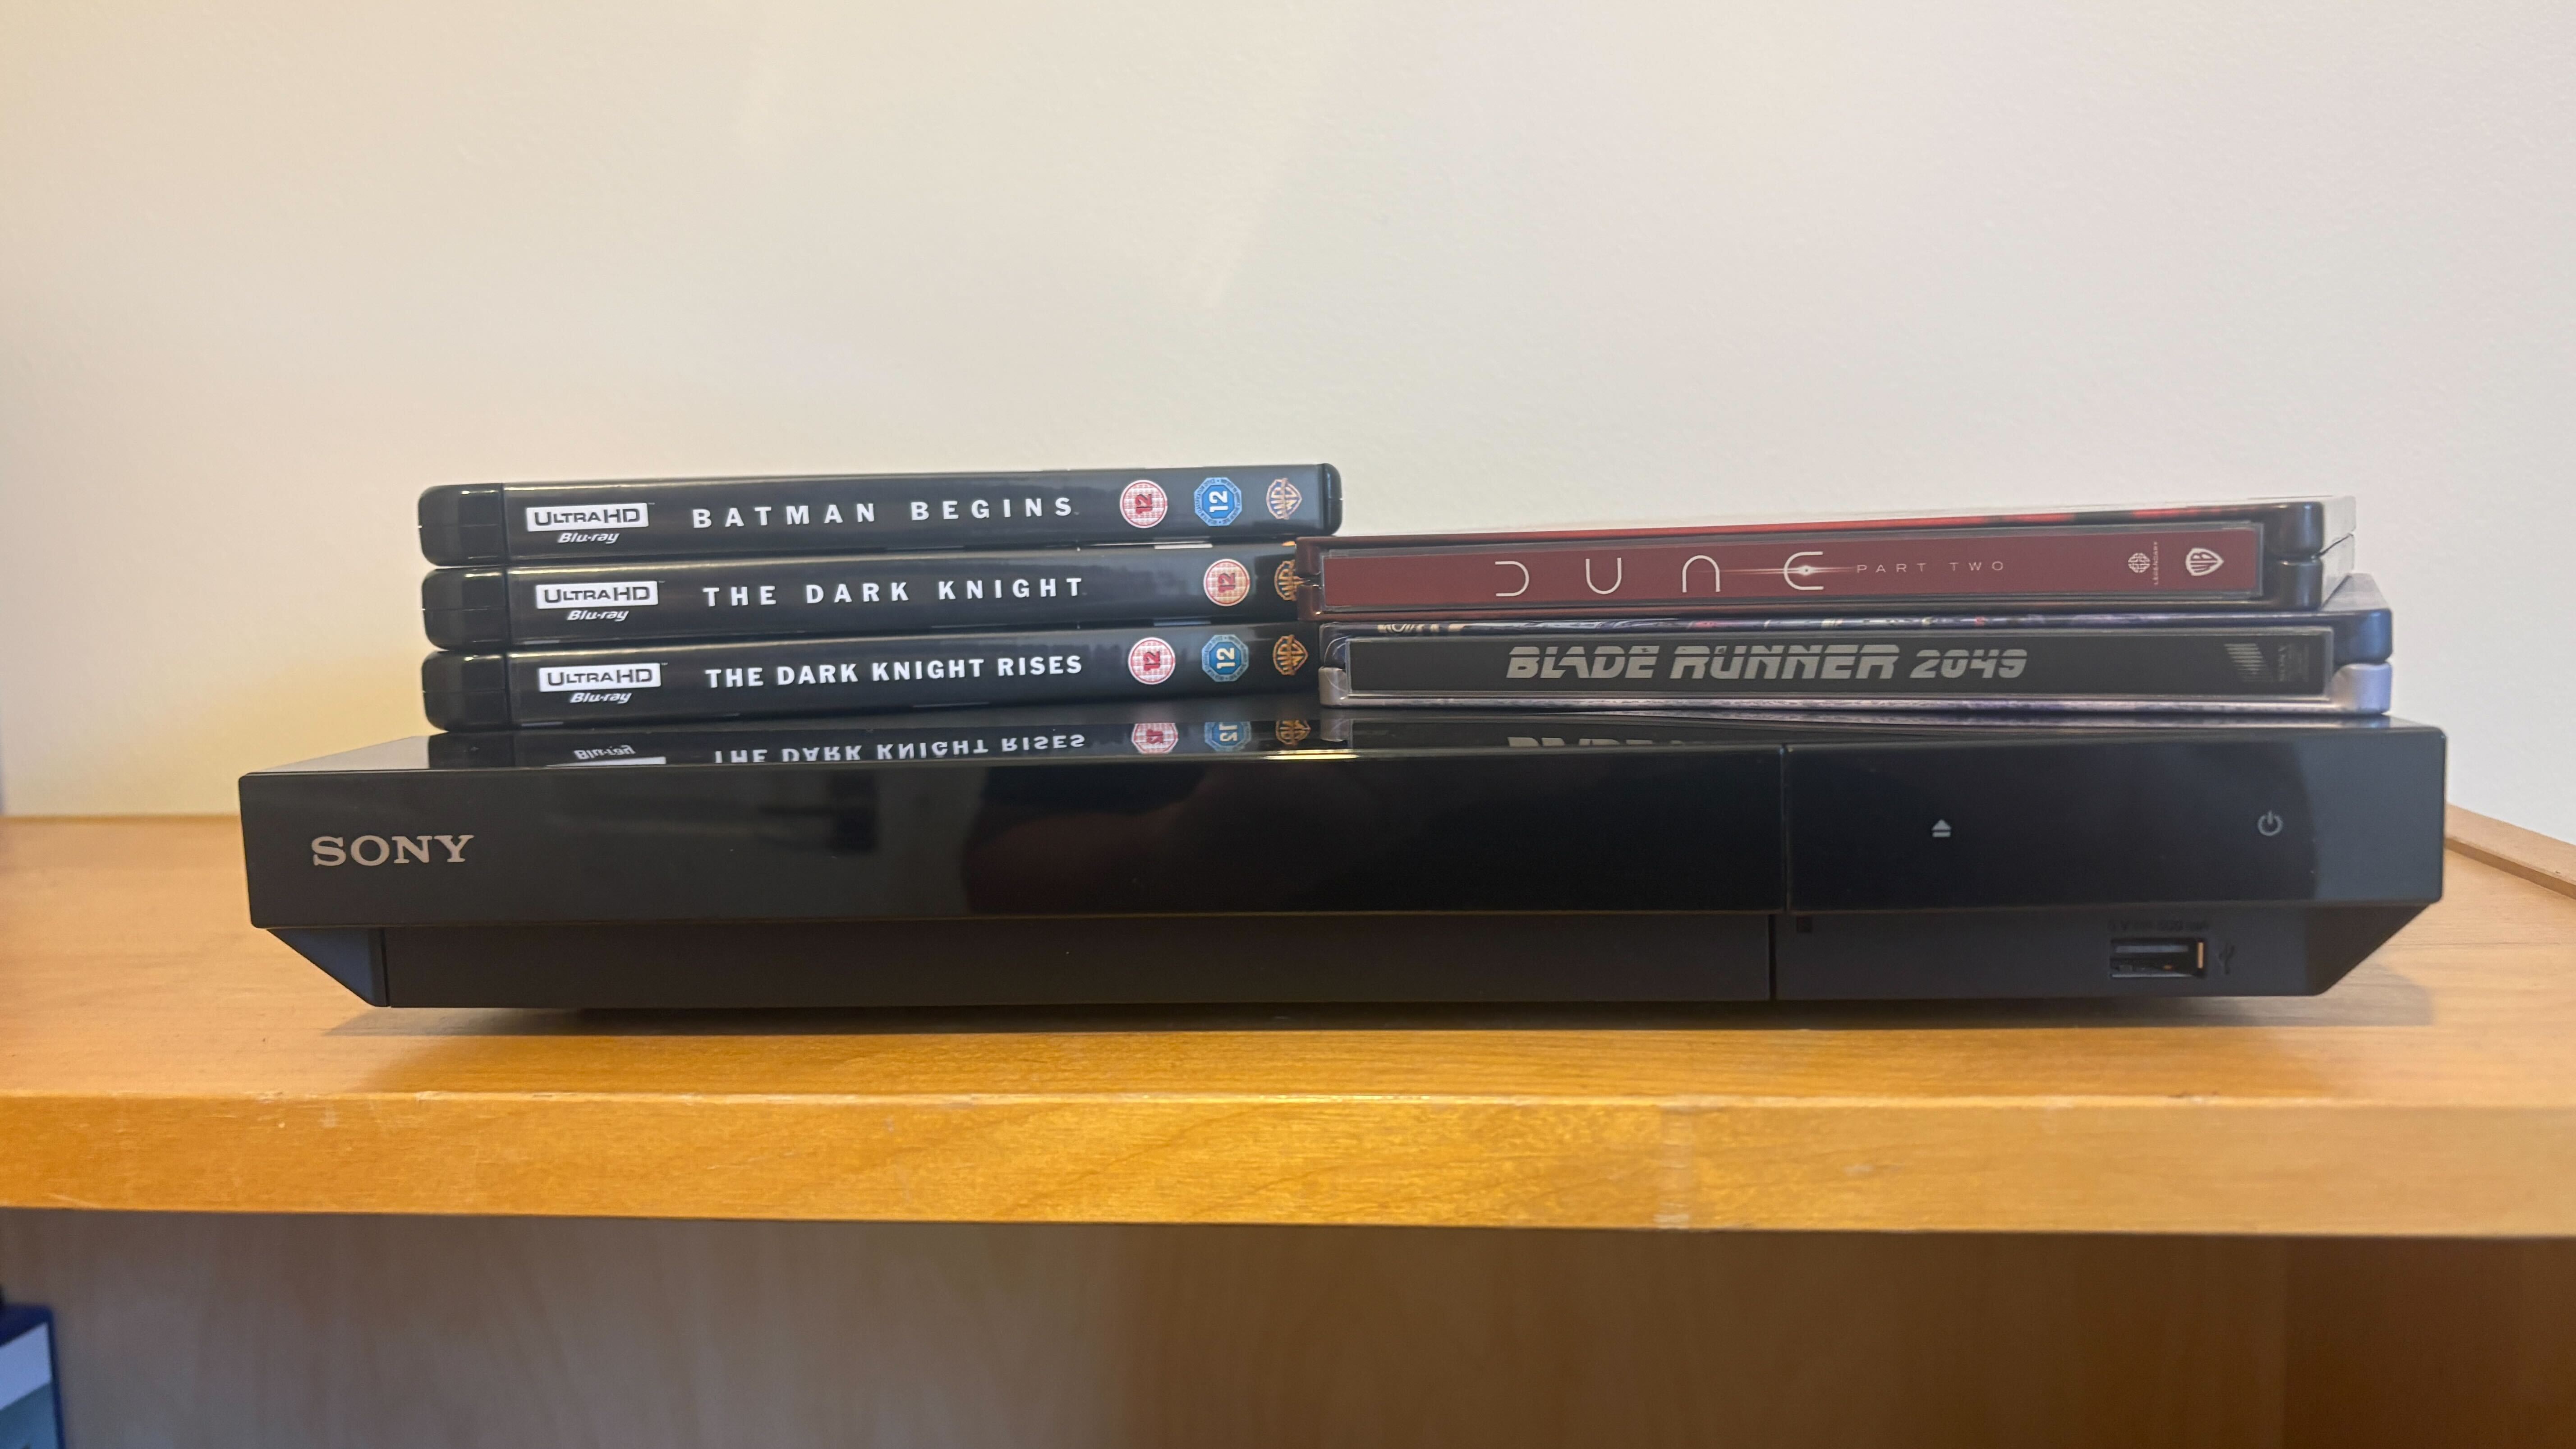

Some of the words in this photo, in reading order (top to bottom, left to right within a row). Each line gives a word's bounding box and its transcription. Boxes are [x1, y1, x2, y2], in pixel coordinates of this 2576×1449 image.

[1135, 494, 1153, 515] 12
[1209, 491, 1228, 512] 12
[692, 503, 874, 528] BATMAN
[911, 497, 1072, 520] BEGINS
[557, 532, 620, 544] Blu-ray
[1218, 573, 1235, 593] 12
[1495, 551, 1824, 596] DUNE
[1856, 563, 1926, 573] PART
[1949, 561, 2003, 571] TWO
[702, 586, 776, 607] THE
[806, 582, 909, 603] DARK
[938, 578, 1082, 600] KNIGHT
[567, 610, 629, 622] Blu-ray
[1143, 651, 1160, 671] 12
[1216, 647, 1235, 669] 12
[1506, 645, 1660, 678] BLADE
[1670, 644, 1900, 679] RUNNER
[1909, 649, 2027, 678] 2049
[705, 667, 764, 688] THE
[777, 663, 858, 685] DARK
[872, 659, 984, 681] KNIGHT
[998, 655, 1081, 676] RISES
[570, 692, 632, 704] Blu-ray
[311, 835, 474, 866] SONY
